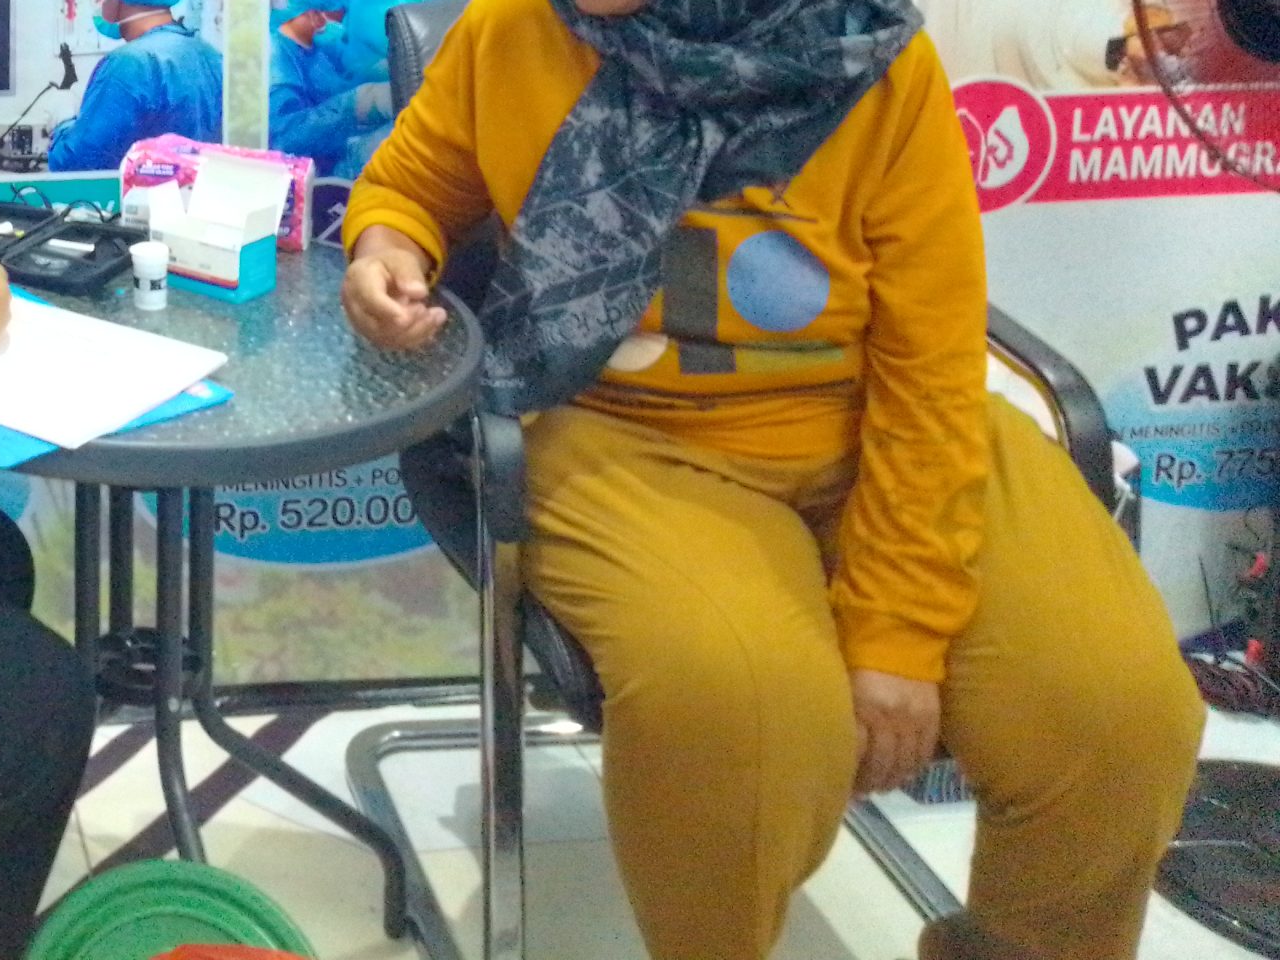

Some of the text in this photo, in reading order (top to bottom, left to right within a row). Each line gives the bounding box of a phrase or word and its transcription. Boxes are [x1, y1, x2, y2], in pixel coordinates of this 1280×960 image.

[1072, 102, 1245, 142] LAYANAN
[1068, 141, 1280, 183] MAMMOGR
[1173, 294, 1280, 351] PAK
[1155, 452, 1202, 488] Rp.
[214, 502, 268, 539] Rp.
